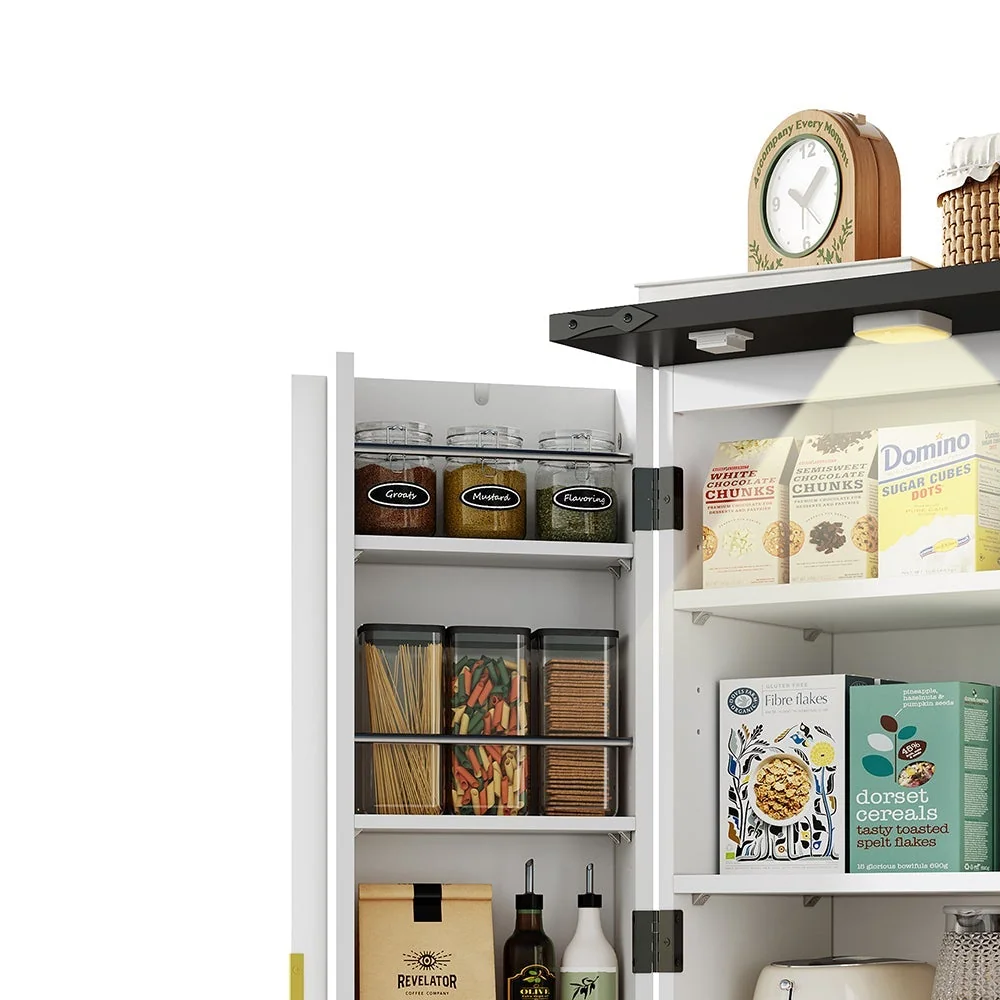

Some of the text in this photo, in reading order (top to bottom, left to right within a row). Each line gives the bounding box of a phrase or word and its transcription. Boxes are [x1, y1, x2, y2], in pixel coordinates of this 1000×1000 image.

[754, 119, 849, 189] Accompany Every Moment
[799, 141, 816, 159] 12
[772, 197, 780, 212] 9
[881, 433, 970, 472] Domino
[710, 470, 757, 480] WHITE
[796, 463, 868, 474] SEMISWEET
[707, 477, 776, 488] CHOCOLATE
[794, 471, 865, 482] CHOCOLATE
[882, 463, 971, 497] SUGAR CUBES
[705, 486, 775, 500] CHUNKS
[792, 480, 863, 493] CHUNKS
[911, 484, 942, 501] DOTS
[385, 489, 417, 500] Groats
[472, 492, 511, 502] Mustard
[563, 494, 606, 505] Flavoring
[765, 691, 828, 706] Fibre flakes
[903, 700, 934, 708] pumpkin
[730, 703, 757, 714] ORGANIC
[856, 788, 929, 805] dorset
[856, 805, 938, 822] cereals
[857, 823, 949, 836] tasty toasted
[857, 836, 936, 849] spelt flakes
[397, 974, 457, 989] REVELATOR
